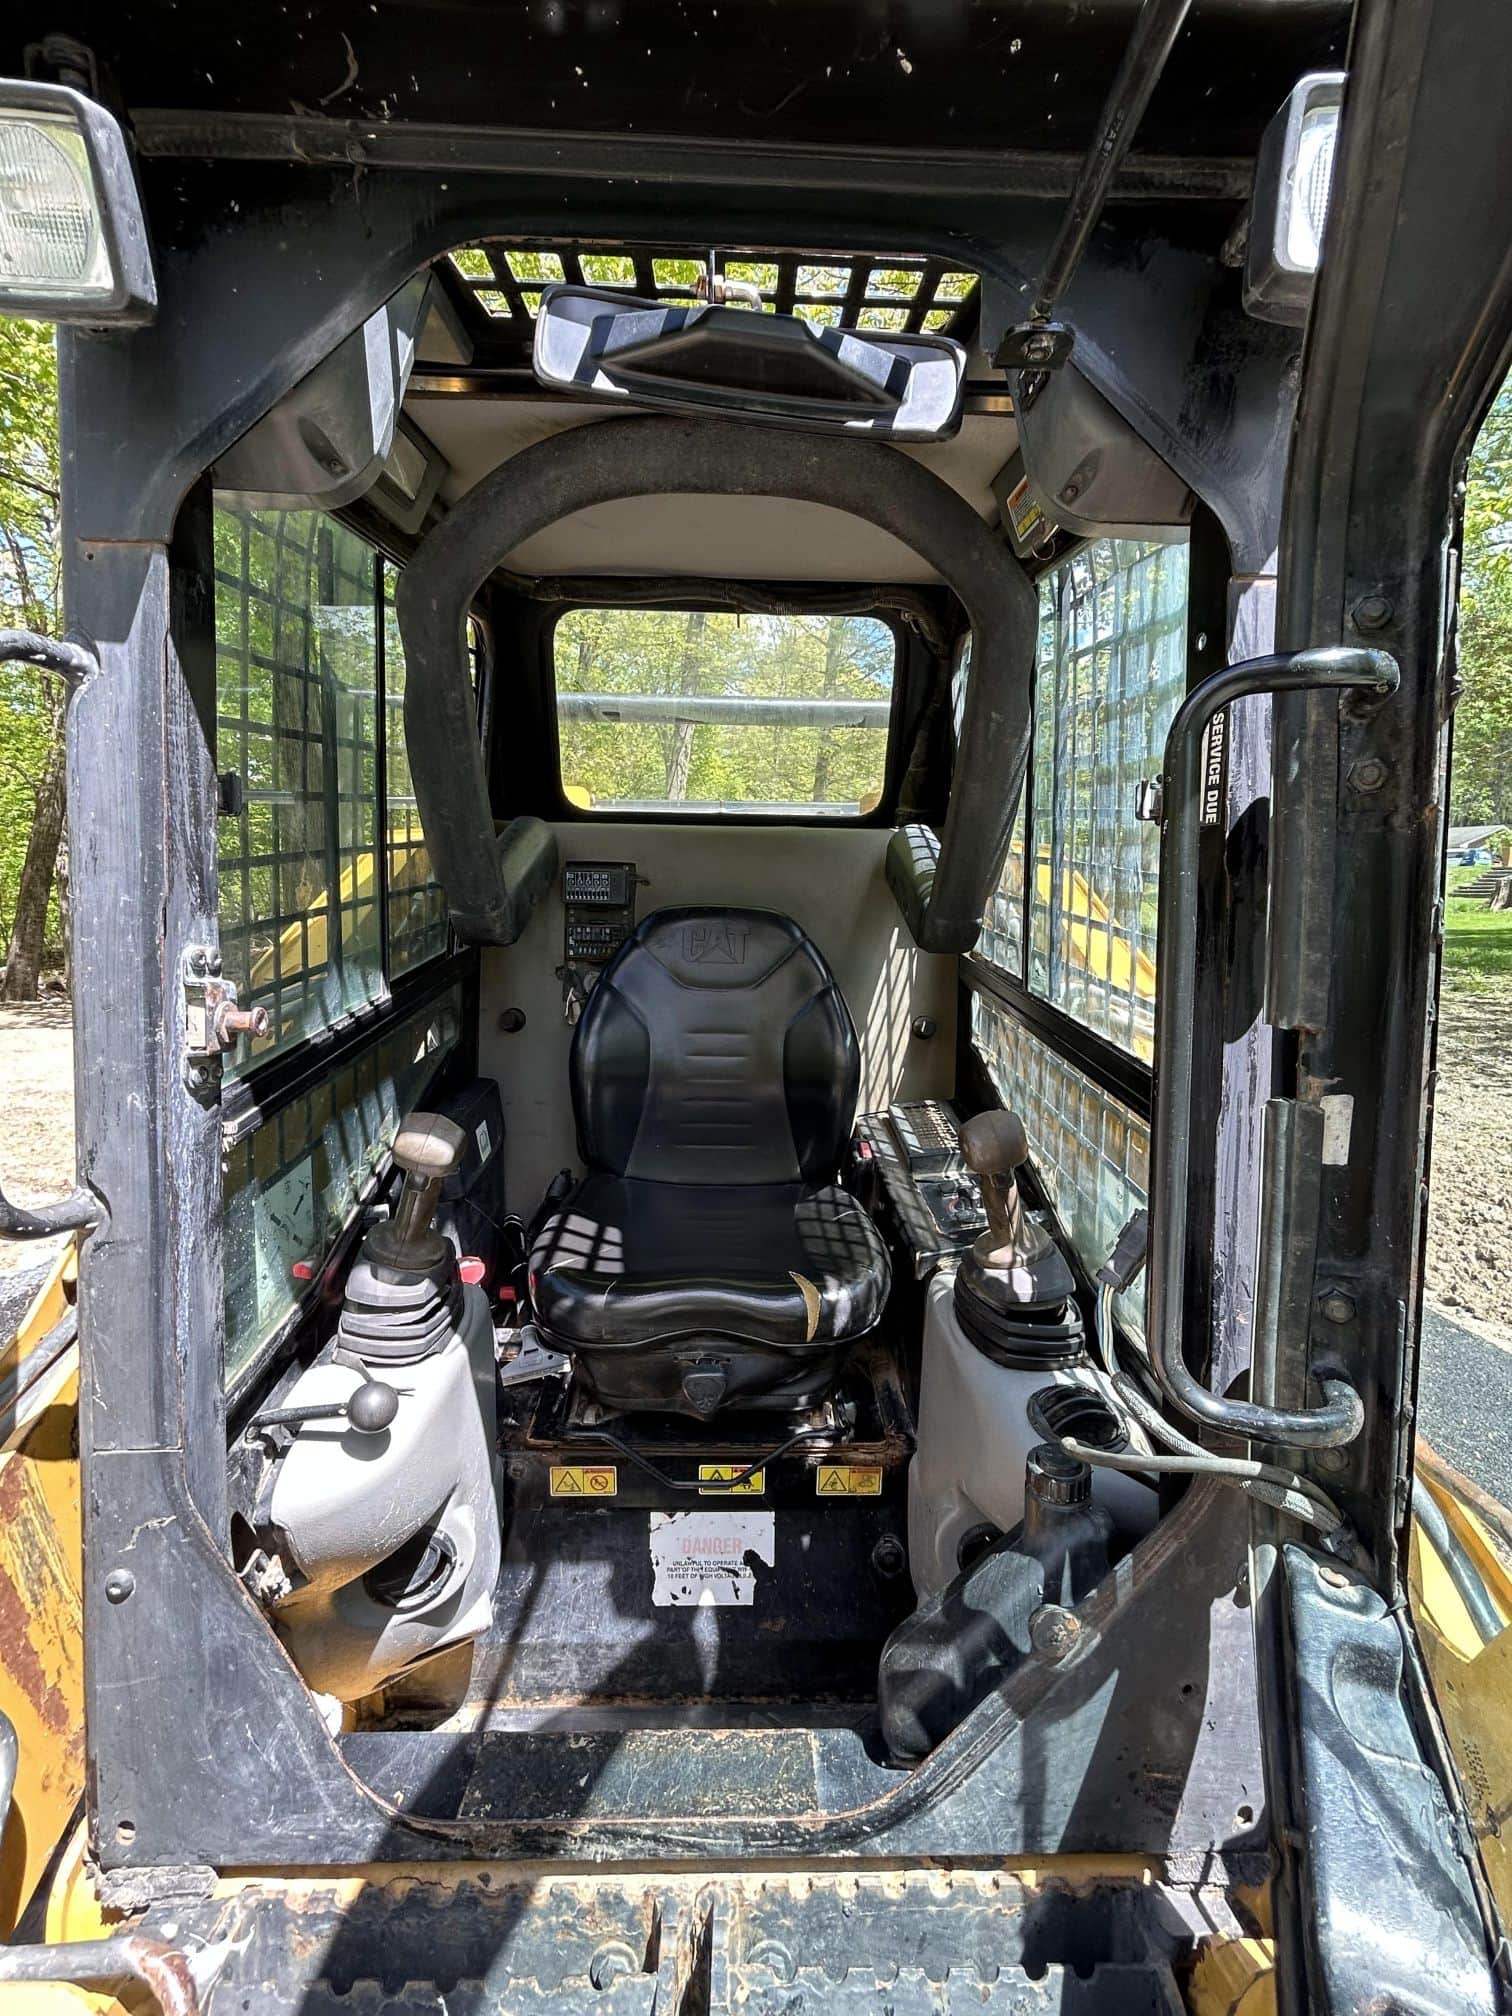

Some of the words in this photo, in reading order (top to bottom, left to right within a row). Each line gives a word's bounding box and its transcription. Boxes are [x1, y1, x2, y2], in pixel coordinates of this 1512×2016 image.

[1208, 712, 1224, 786] SERVICE
[1205, 790, 1219, 825] DUE
[682, 926, 751, 965] CAT
[681, 1536, 743, 1554] DANGER
